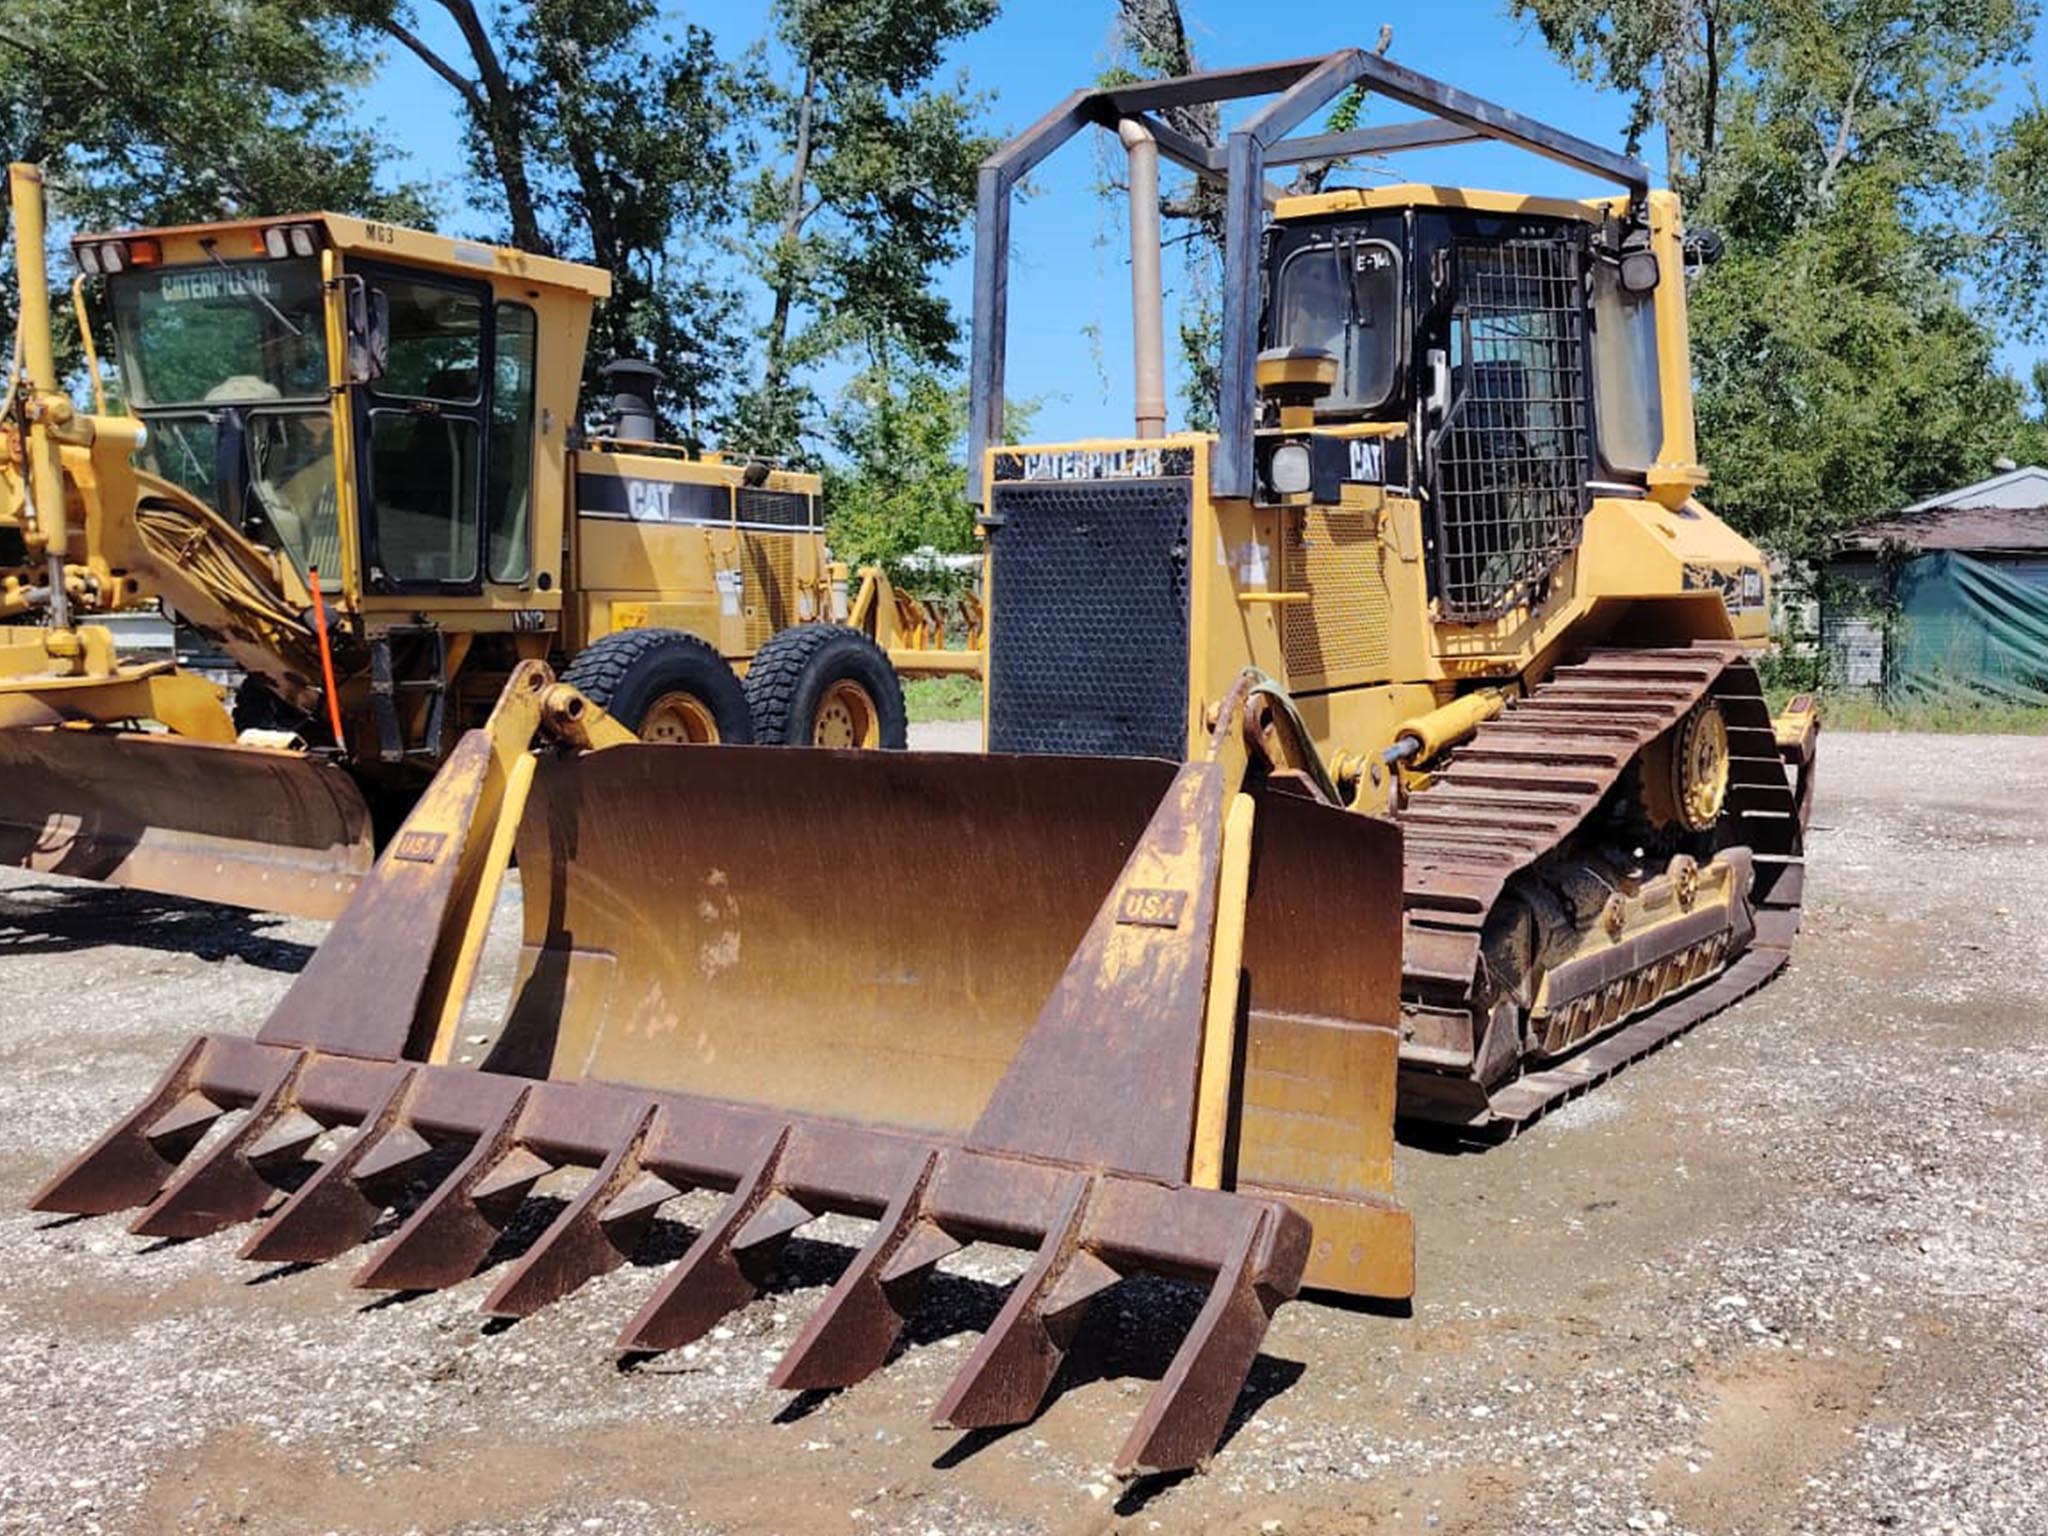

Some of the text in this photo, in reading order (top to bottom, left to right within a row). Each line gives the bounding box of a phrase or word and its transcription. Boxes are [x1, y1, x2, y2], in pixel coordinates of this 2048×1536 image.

[1024, 450, 1163, 481] CATERPILLAR
[1350, 440, 1380, 481] CAT
[629, 481, 673, 520] CAT
[1126, 894, 1175, 920] USA
